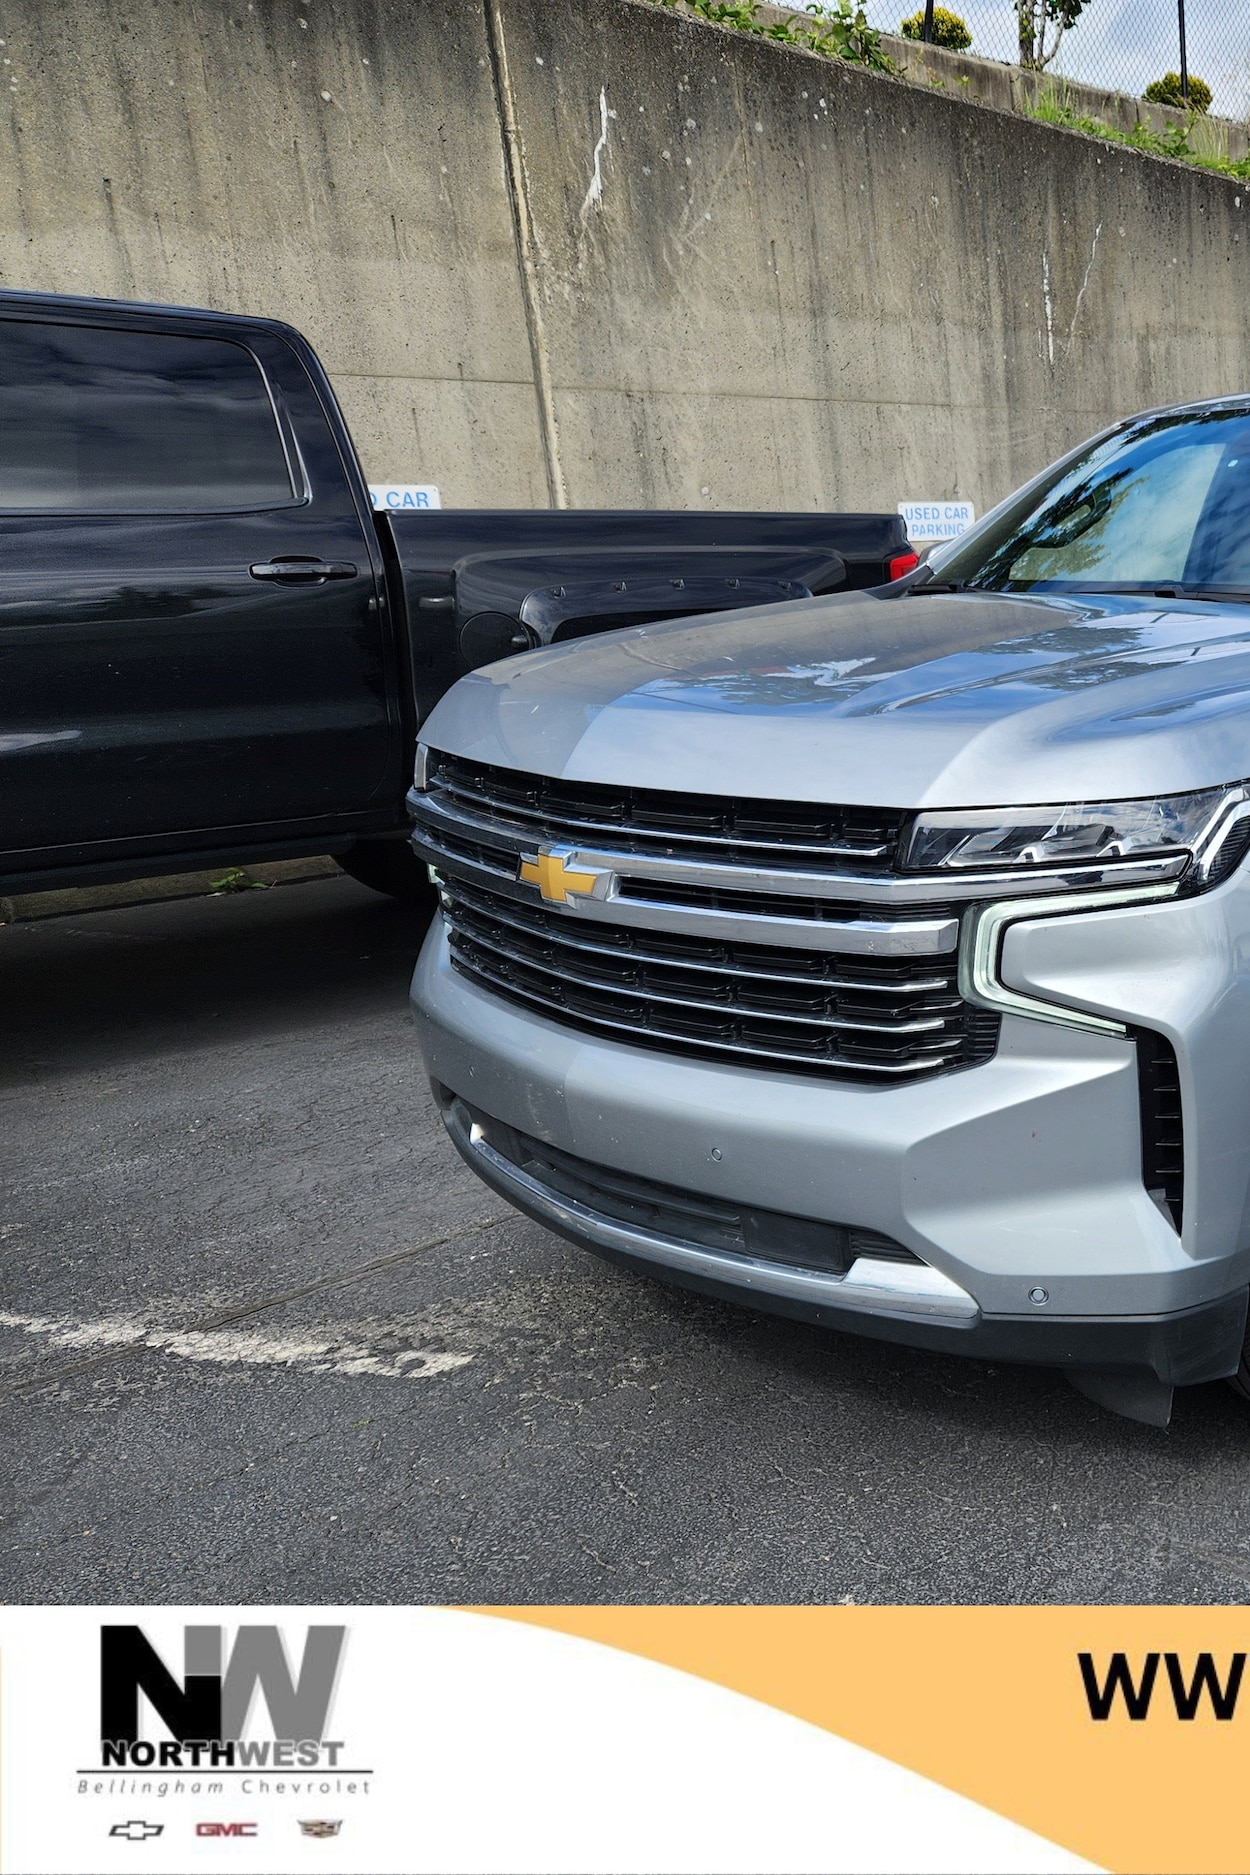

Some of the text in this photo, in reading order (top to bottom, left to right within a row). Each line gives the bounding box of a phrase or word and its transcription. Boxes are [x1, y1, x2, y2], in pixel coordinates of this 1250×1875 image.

[386, 491, 430, 508] CAR
[905, 507, 969, 520] USED CAR
